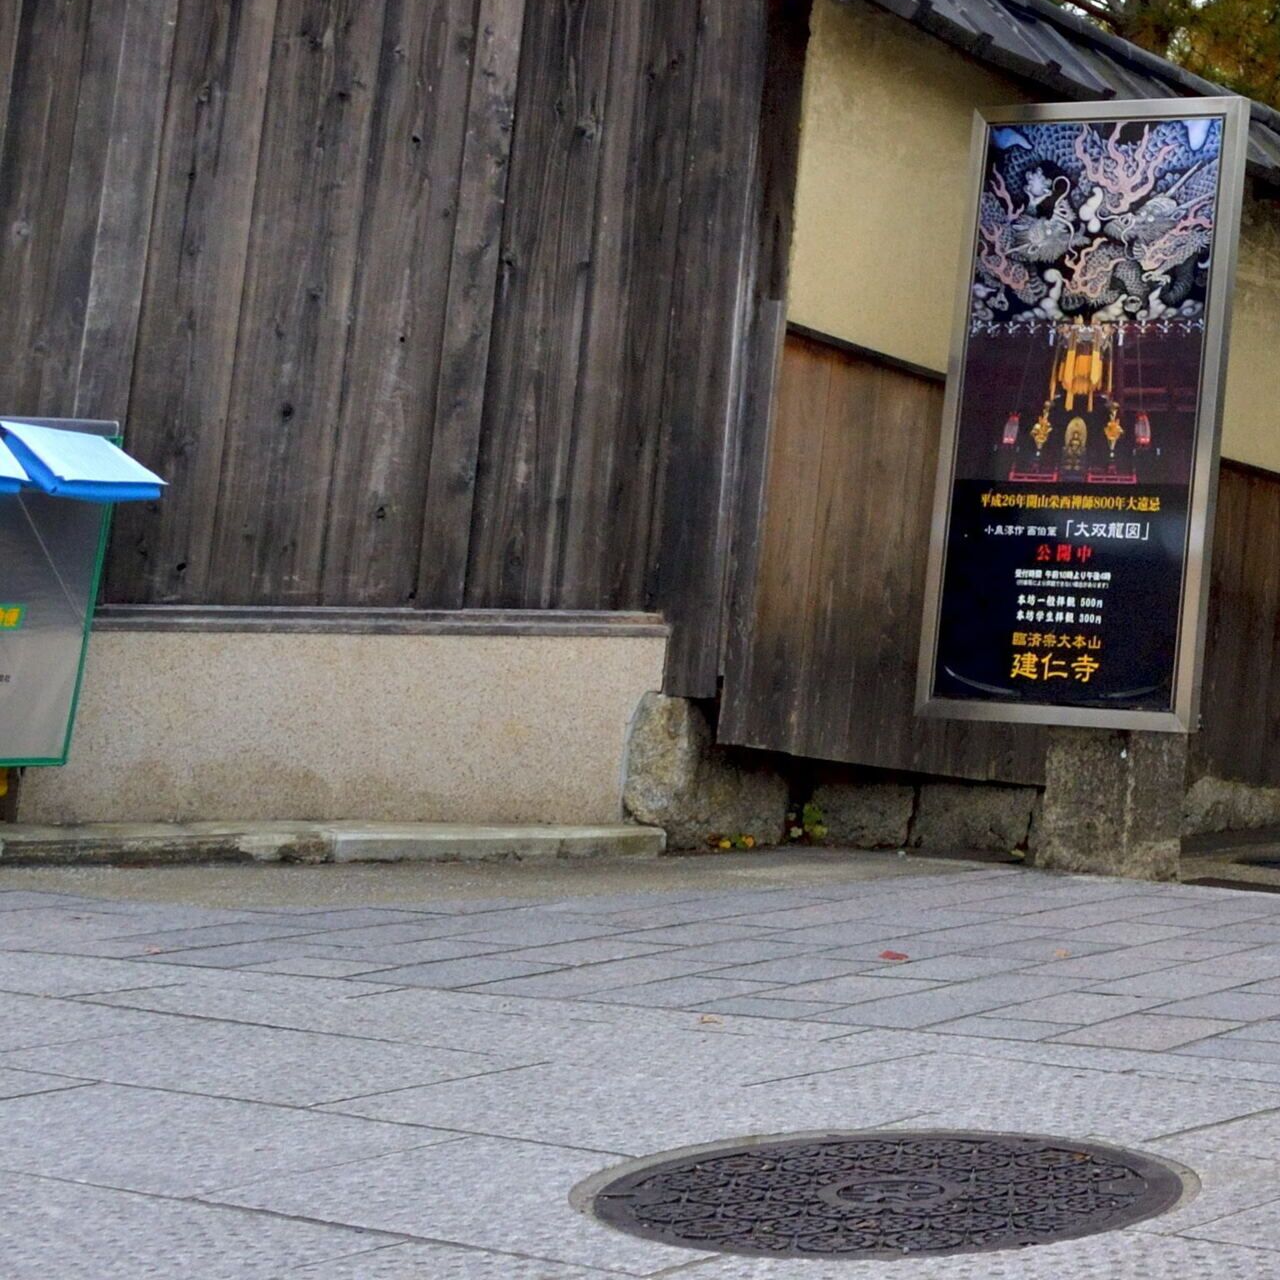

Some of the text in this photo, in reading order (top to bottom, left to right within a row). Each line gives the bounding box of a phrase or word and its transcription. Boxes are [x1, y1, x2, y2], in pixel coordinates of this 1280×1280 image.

[1036, 543, 1092, 563] 公開中
[1080, 597, 1103, 608] 500円
[1010, 651, 1099, 682] 建仁寺
